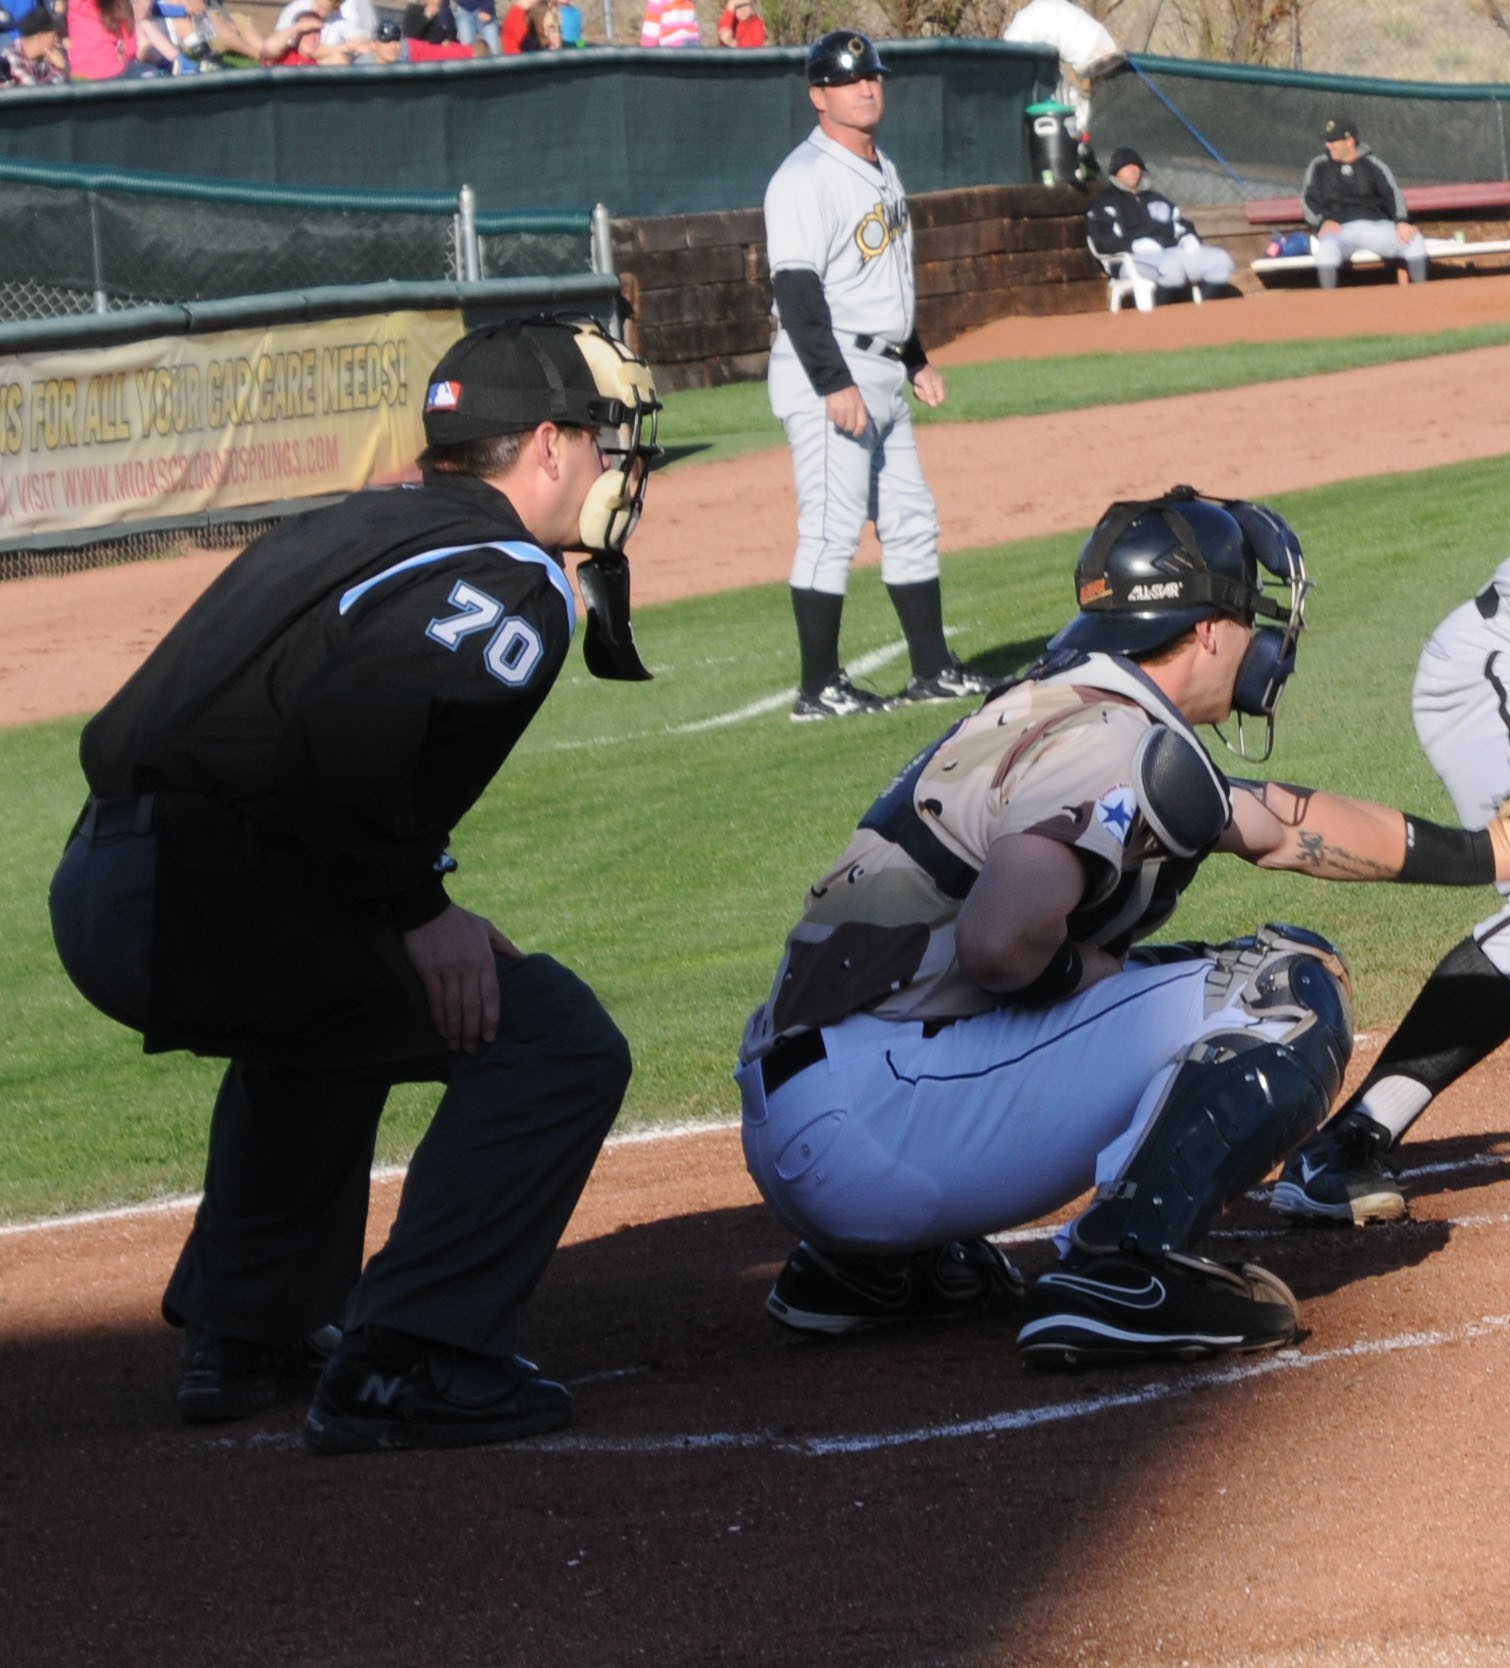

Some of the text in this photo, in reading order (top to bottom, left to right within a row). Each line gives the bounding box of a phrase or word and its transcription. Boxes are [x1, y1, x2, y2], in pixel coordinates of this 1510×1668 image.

[30, 377, 78, 453] FOR
[82, 371, 132, 446] ALL
[135, 365, 204, 438] YOUR
[206, 357, 254, 430] CAR
[256, 347, 316, 424] CARE
[321, 339, 408, 415] NEEDS!
[15, 470, 56, 514] VISIT
[425, 578, 544, 687] 70
